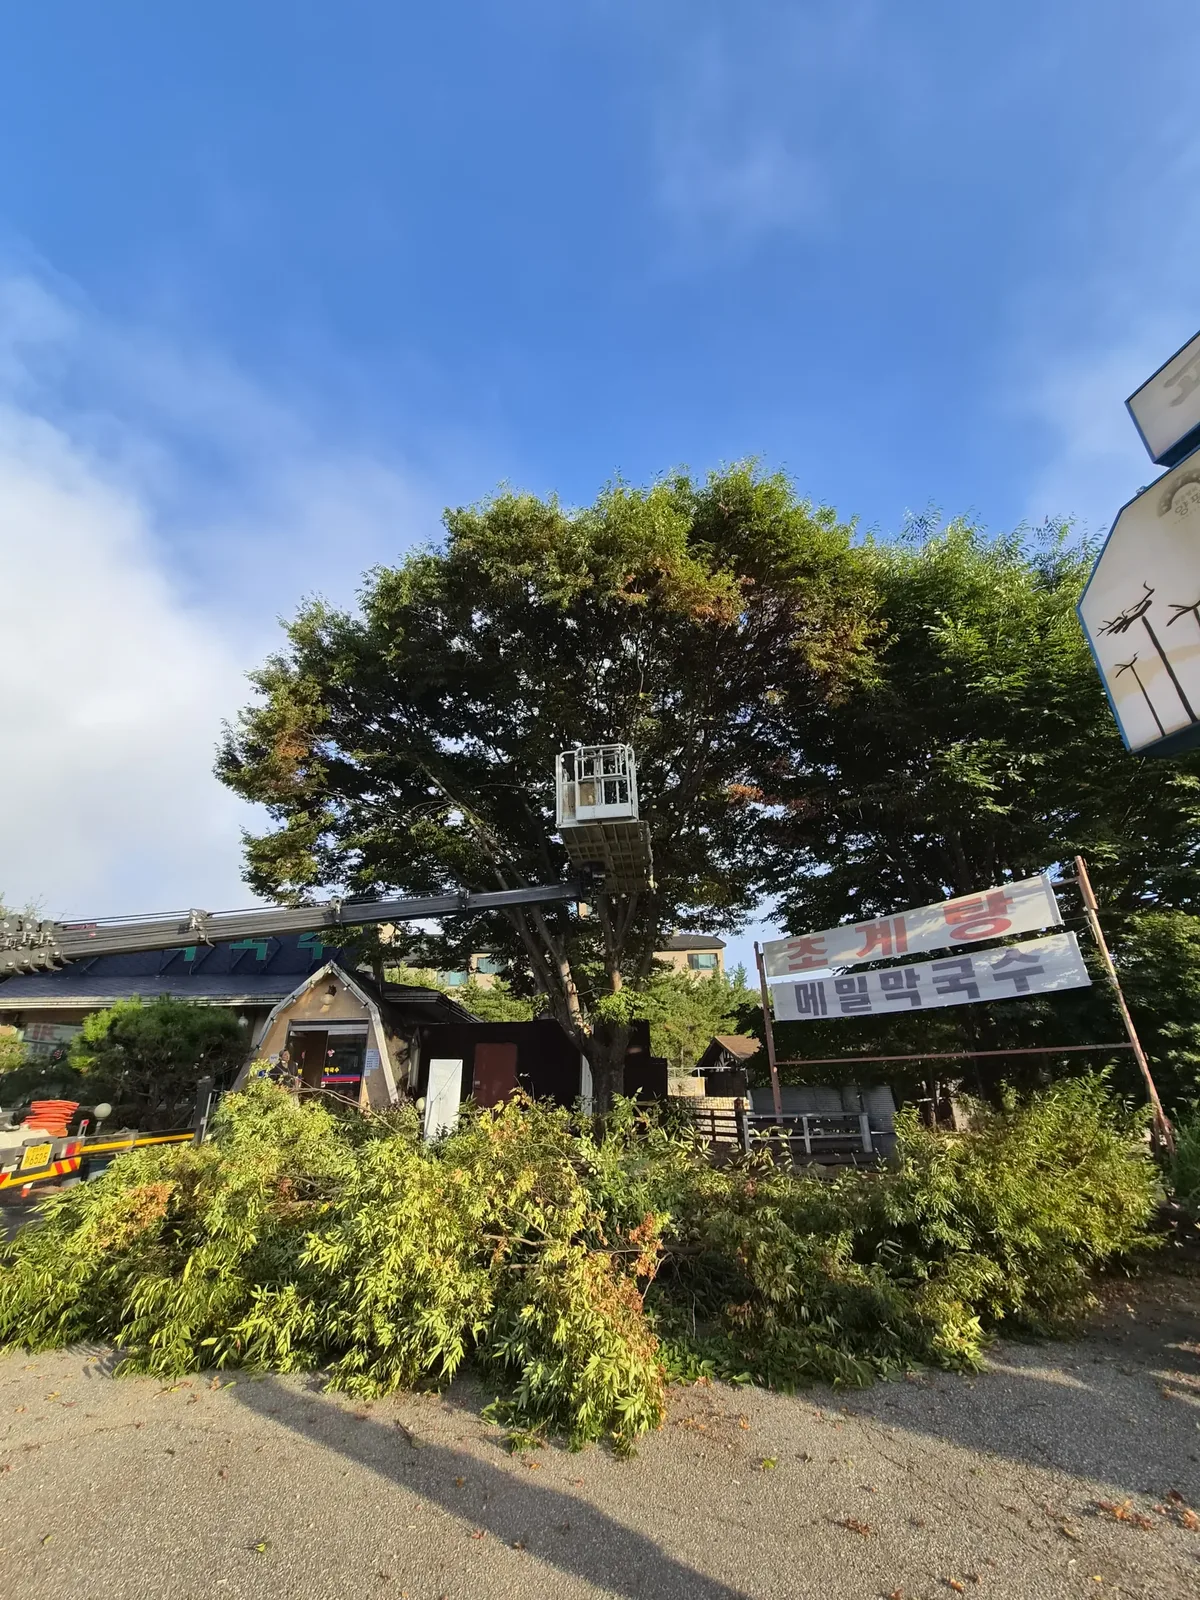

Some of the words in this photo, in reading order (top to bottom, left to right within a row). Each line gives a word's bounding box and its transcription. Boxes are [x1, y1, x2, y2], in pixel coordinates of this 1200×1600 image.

[787, 891, 1013, 972] 초계탕
[794, 948, 1045, 1017] 메밀막국수
[29, 1153, 47, 1165] 6525
